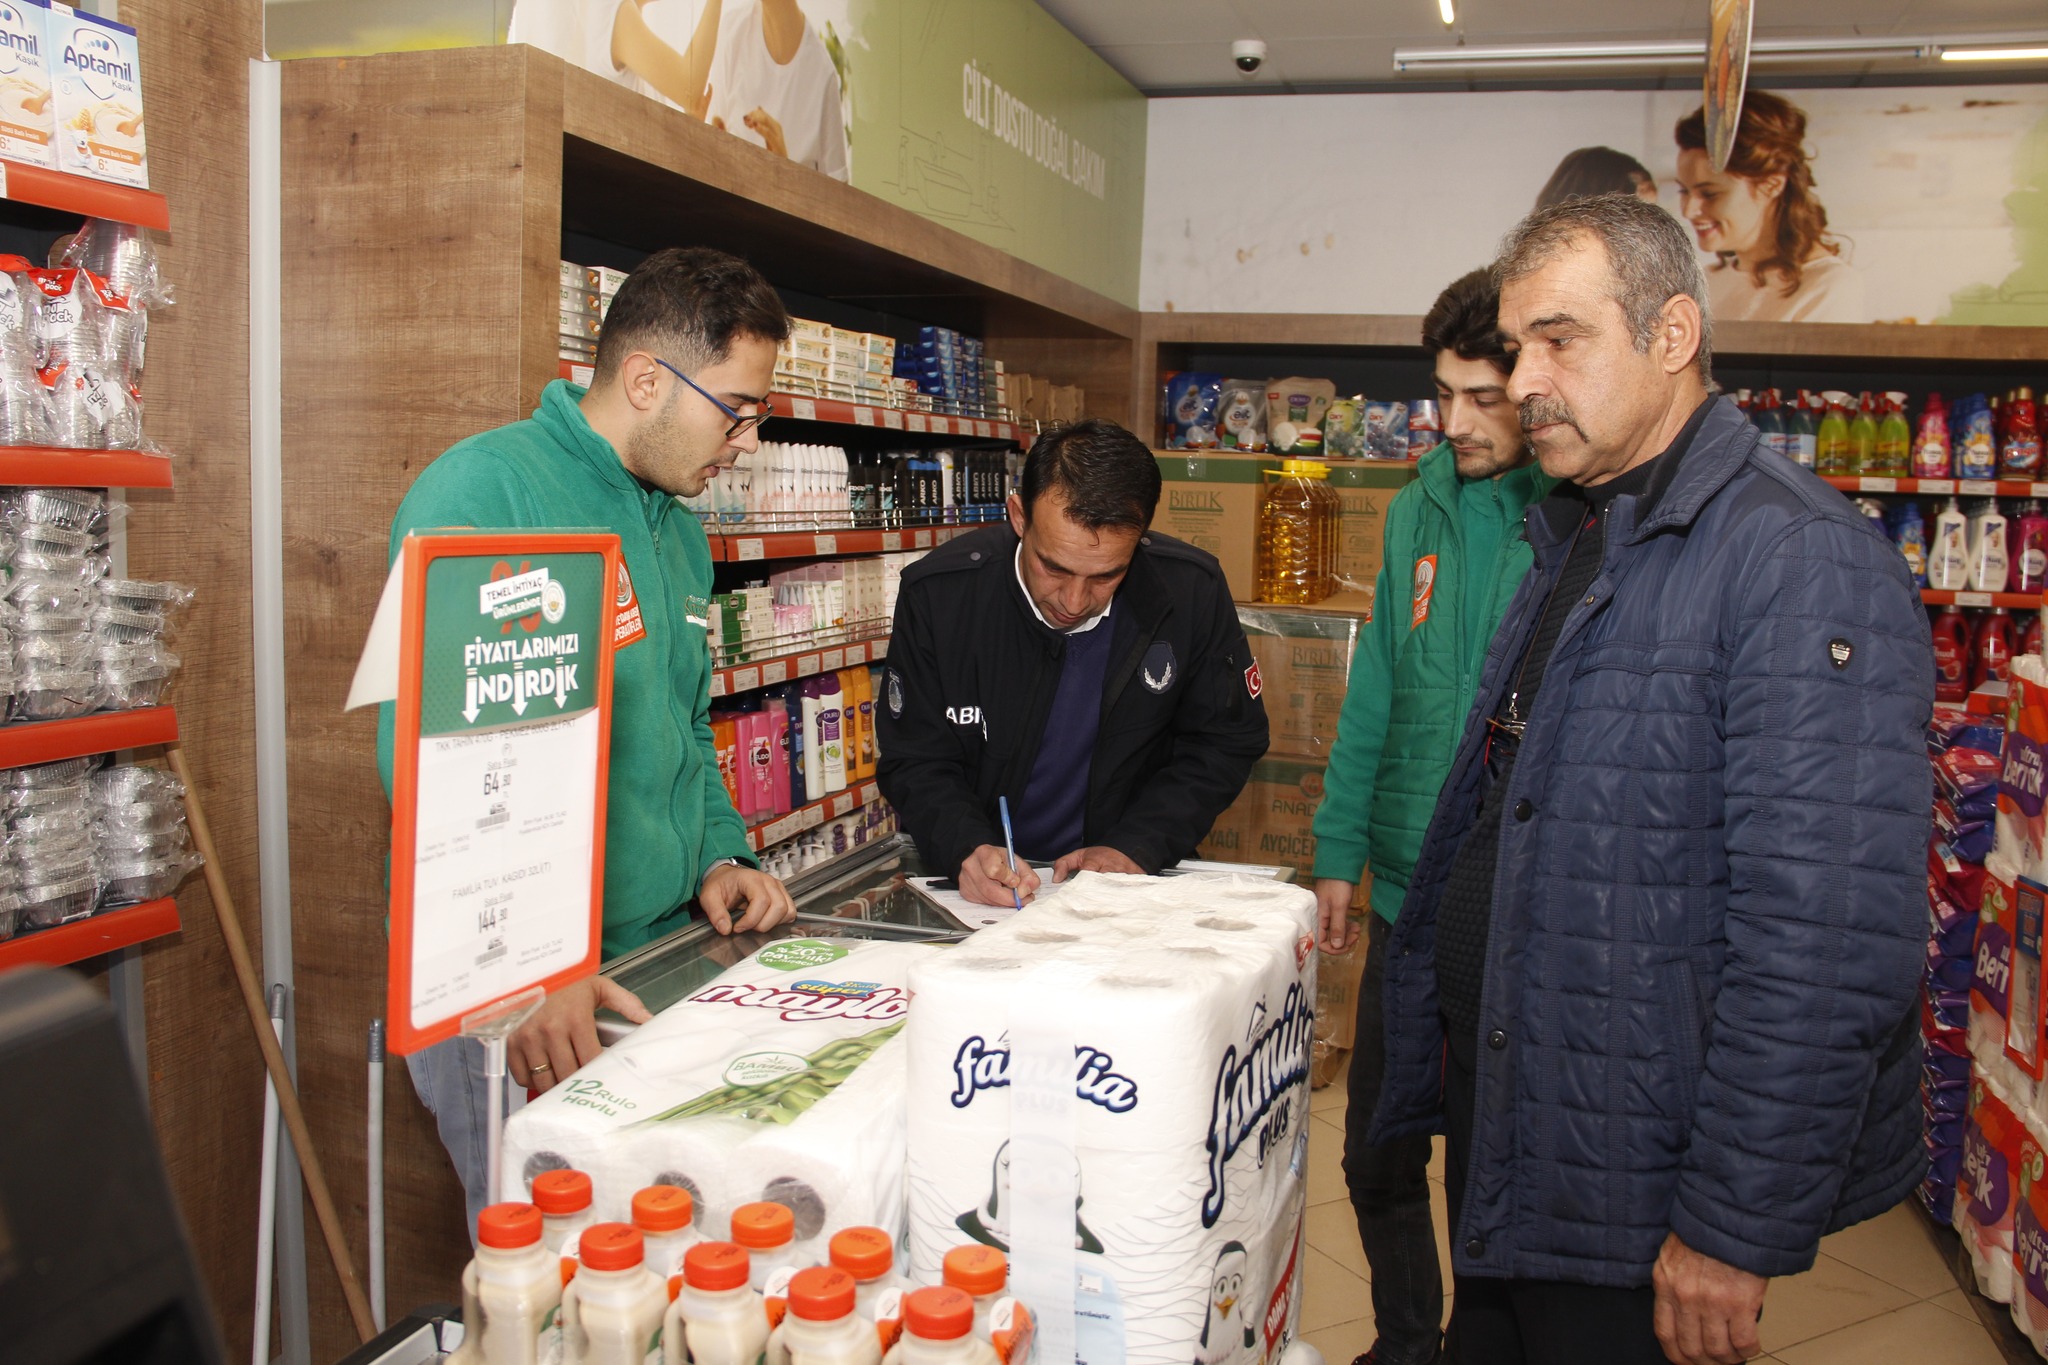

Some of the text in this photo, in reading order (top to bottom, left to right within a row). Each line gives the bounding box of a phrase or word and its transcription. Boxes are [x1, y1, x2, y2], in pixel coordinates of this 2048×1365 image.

[15, 52, 40, 67] Kaşık
[63, 45, 133, 83] Aptamil
[111, 79, 134, 93] Kaşık
[963, 58, 992, 130] CİLT
[994, 84, 1034, 157] DOSTU
[1035, 113, 1070, 181] DOĞAL
[486, 577, 542, 601] TEMEL İHTİYAÇ
[464, 634, 579, 666] FİYATLARIMIZI
[463, 658, 579, 716] İNDİRDİK
[823, 711, 840, 719] DURU
[484, 772, 499, 795] 64
[478, 907, 496, 933] 144
[796, 983, 869, 995] süper
[733, 1062, 801, 1072] BAMBU
[561, 1095, 617, 1116] Havlu
[565, 1079, 637, 1110] 12 Rulo
[1257, 1096, 1291, 1170] PLUS
